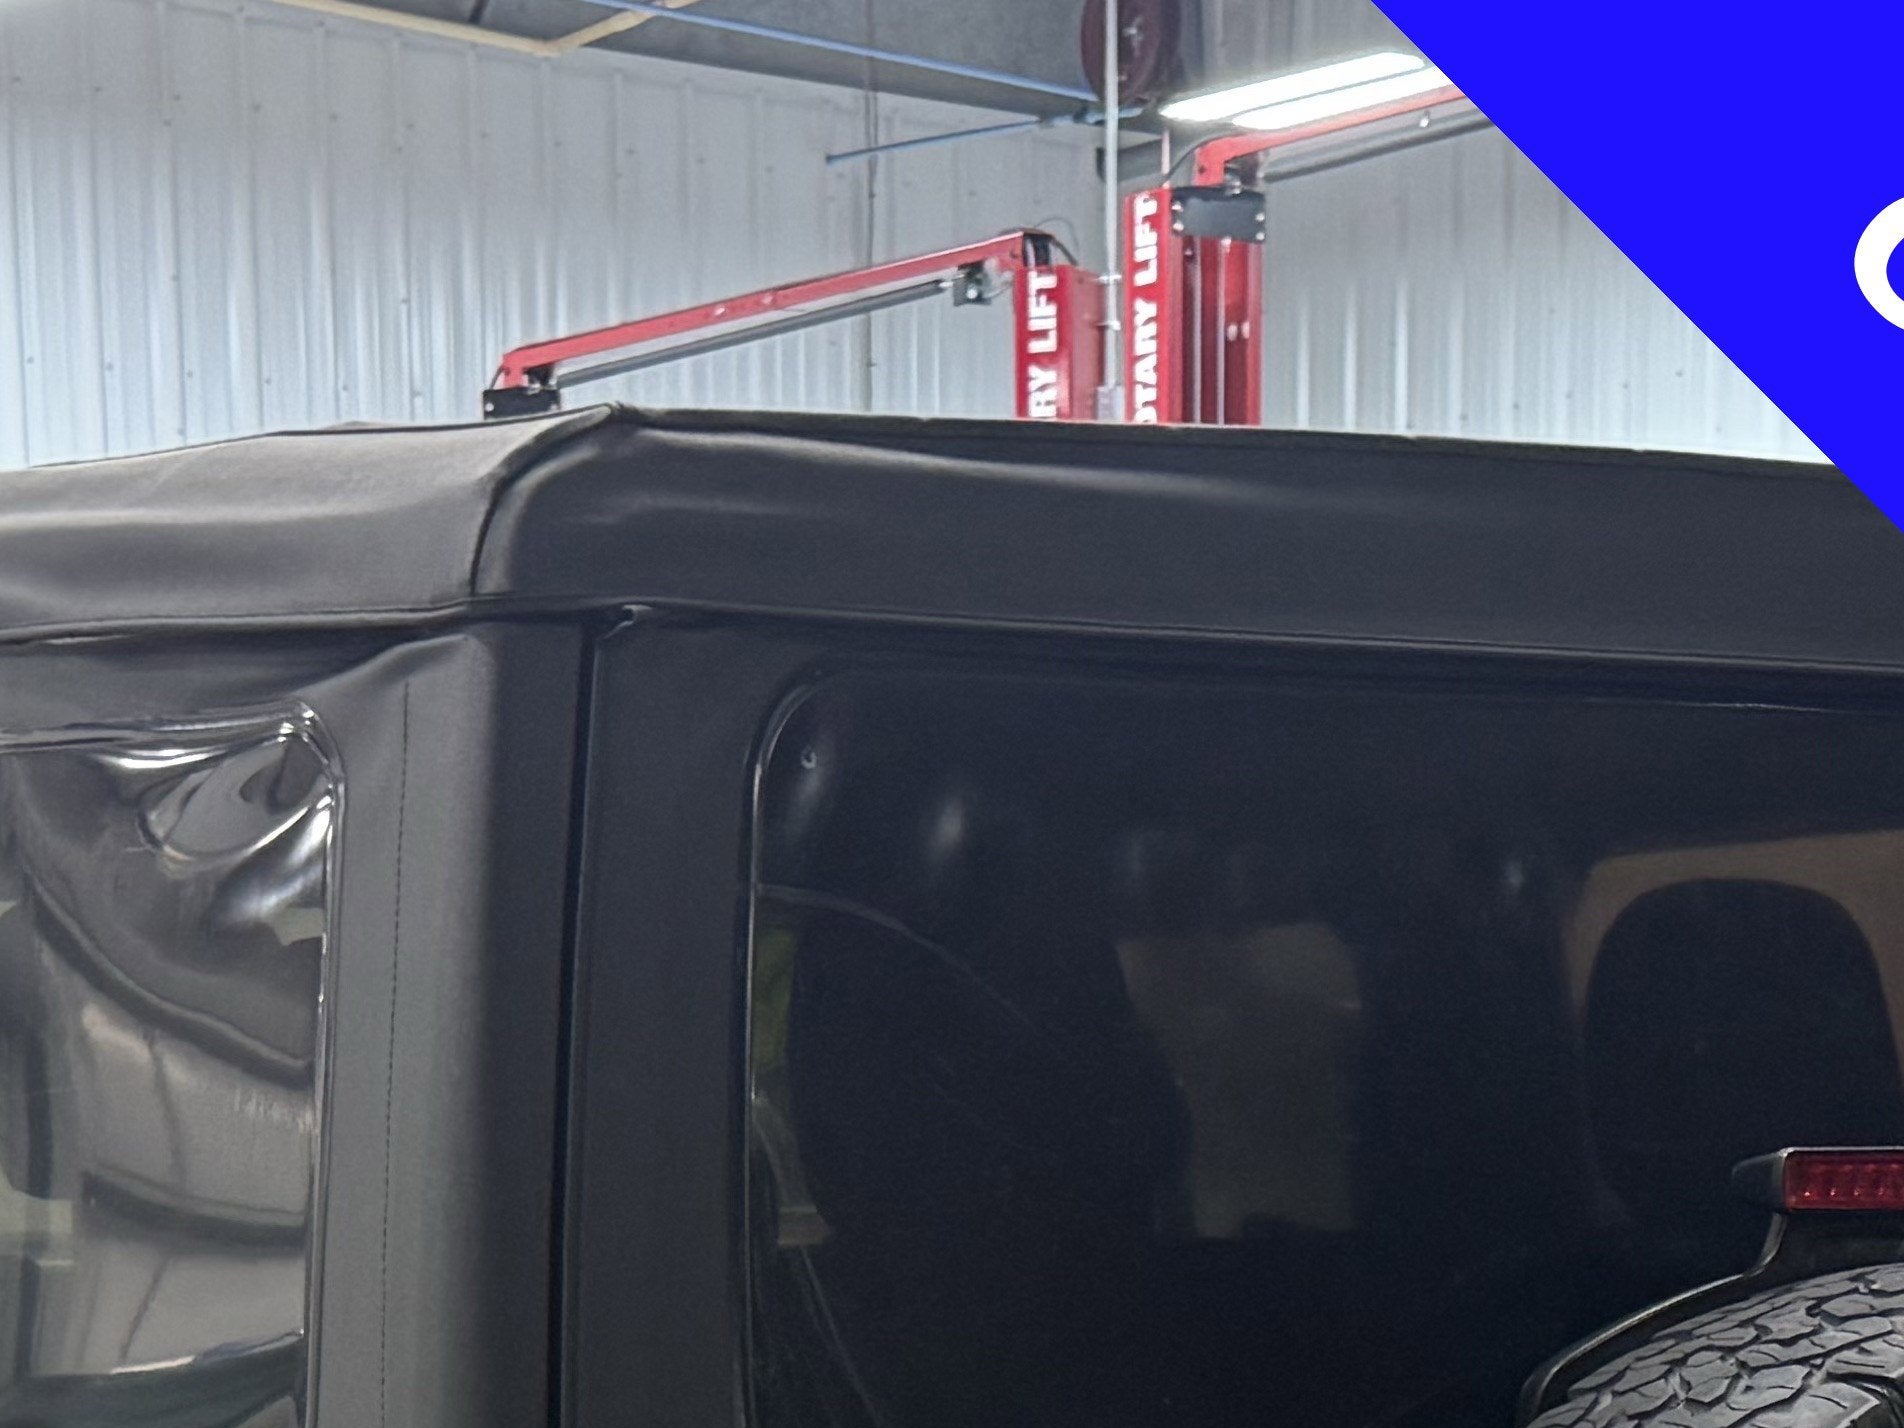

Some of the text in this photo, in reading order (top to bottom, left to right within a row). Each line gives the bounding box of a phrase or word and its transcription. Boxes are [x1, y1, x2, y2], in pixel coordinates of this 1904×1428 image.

[1027, 270, 1058, 418] RY LIFT
[1133, 192, 1158, 424] OTARY LIFT
